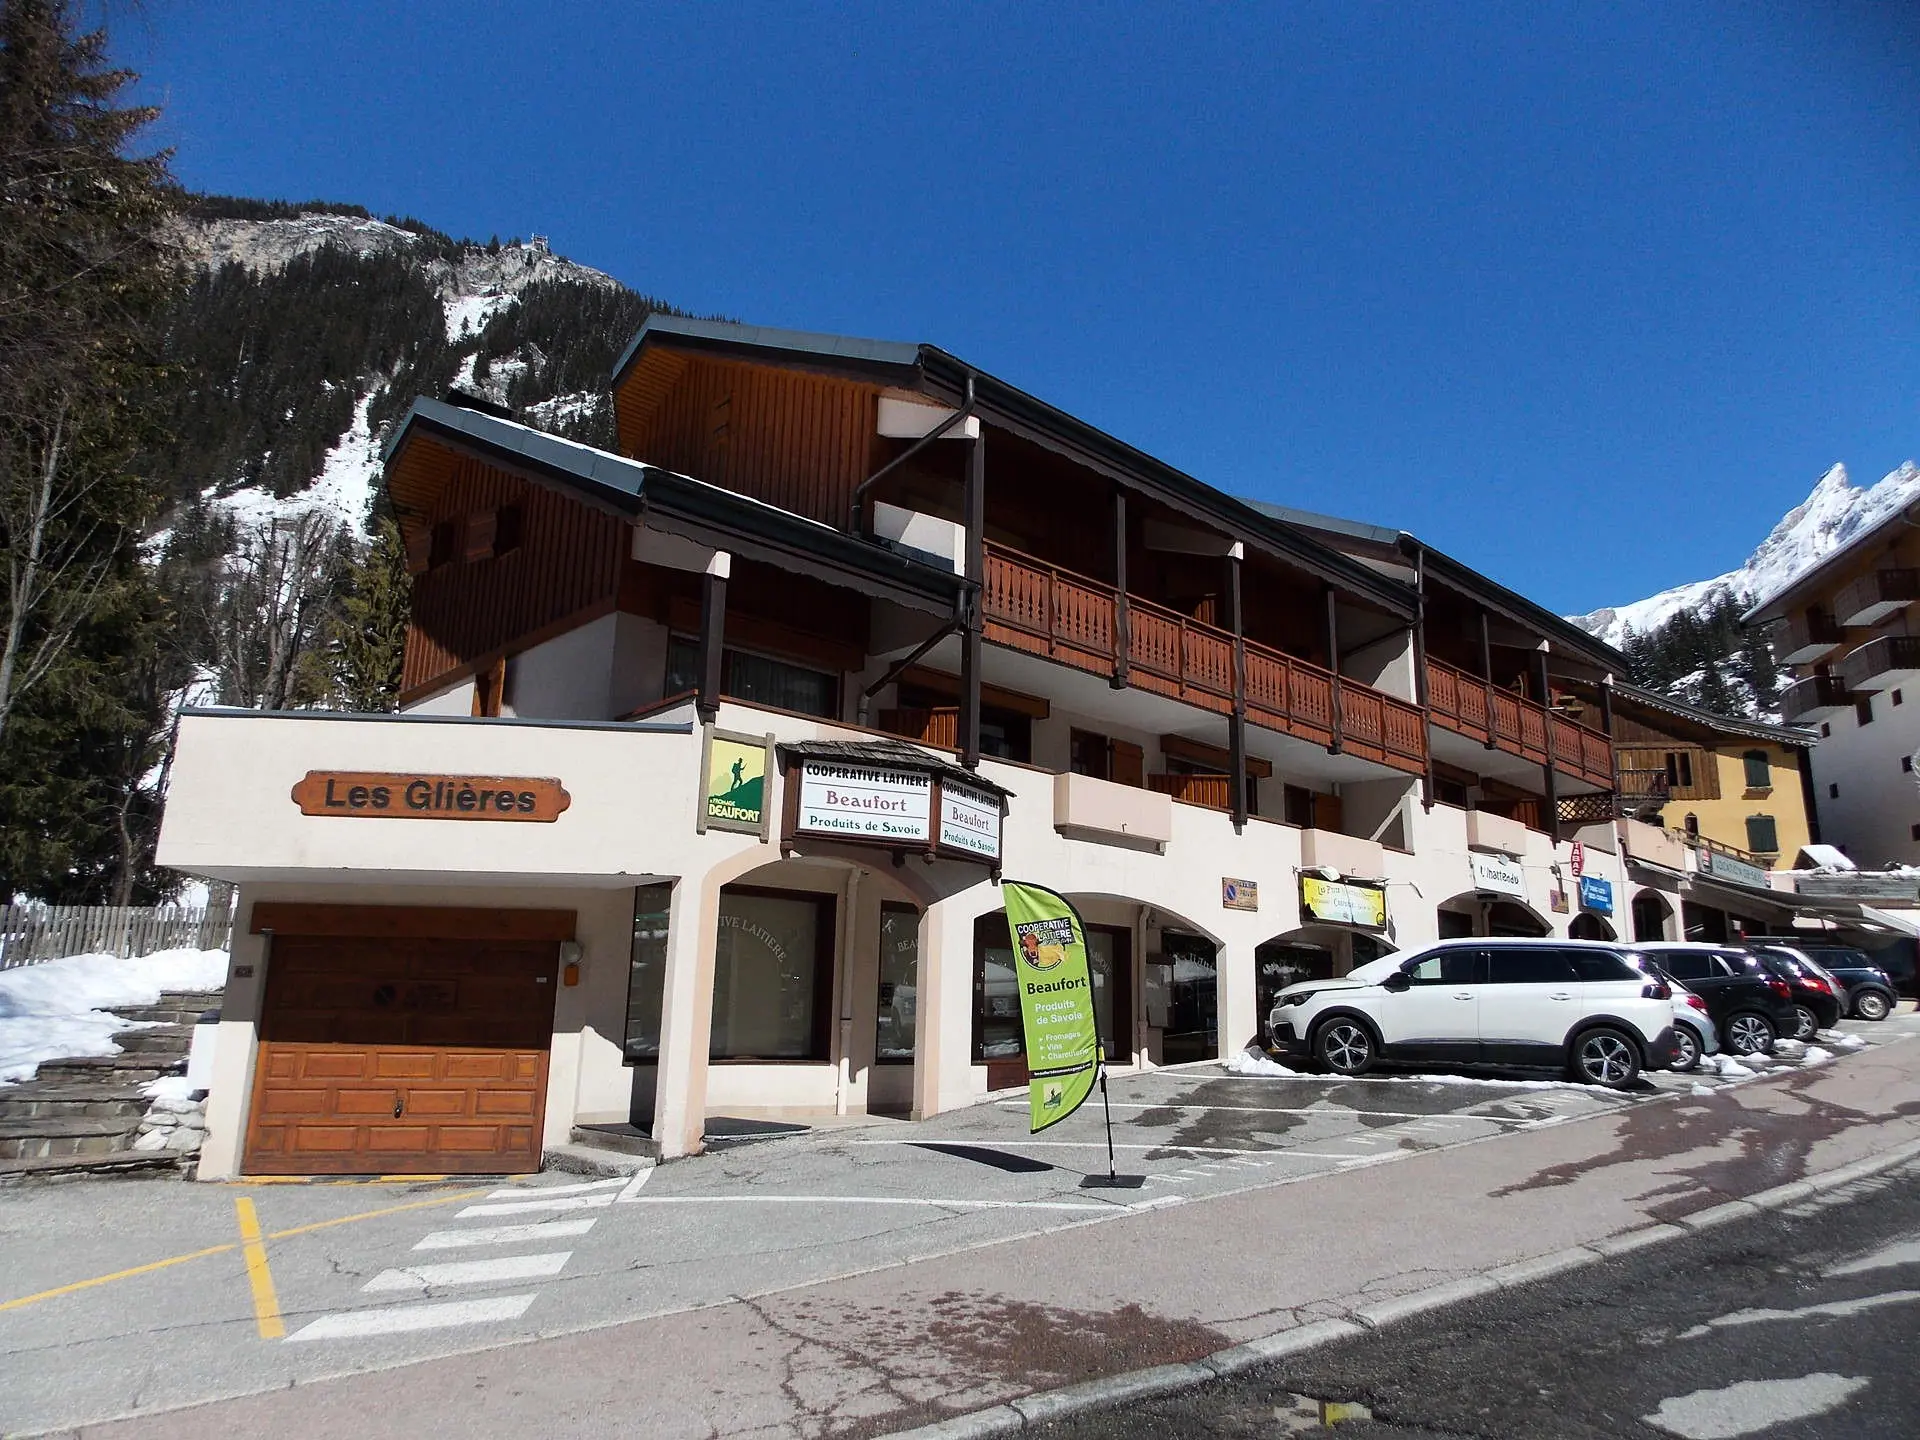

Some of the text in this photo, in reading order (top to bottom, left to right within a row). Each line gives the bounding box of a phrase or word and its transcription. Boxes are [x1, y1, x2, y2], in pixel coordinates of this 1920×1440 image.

[806, 763, 929, 788] COOPERATIVE LAITIERE
[325, 779, 536, 813] Les Glières
[826, 790, 907, 811] Beaufort
[709, 803, 760, 822] BEAUFORT
[952, 807, 989, 830] Beaufort
[810, 815, 920, 834] Produits de Savoie
[944, 830, 995, 853] Produits de Savoie
[1572, 842, 1580, 876] TABAC
[1017, 919, 1070, 934] COOPERATIVE
[1038, 929, 1071, 941] LAITIERE
[1027, 977, 1087, 995] Beaufort
[1035, 1000, 1075, 1013] Produits
[1037, 1012, 1083, 1025] de Savoie
[1046, 1032, 1081, 1041] Fromages
